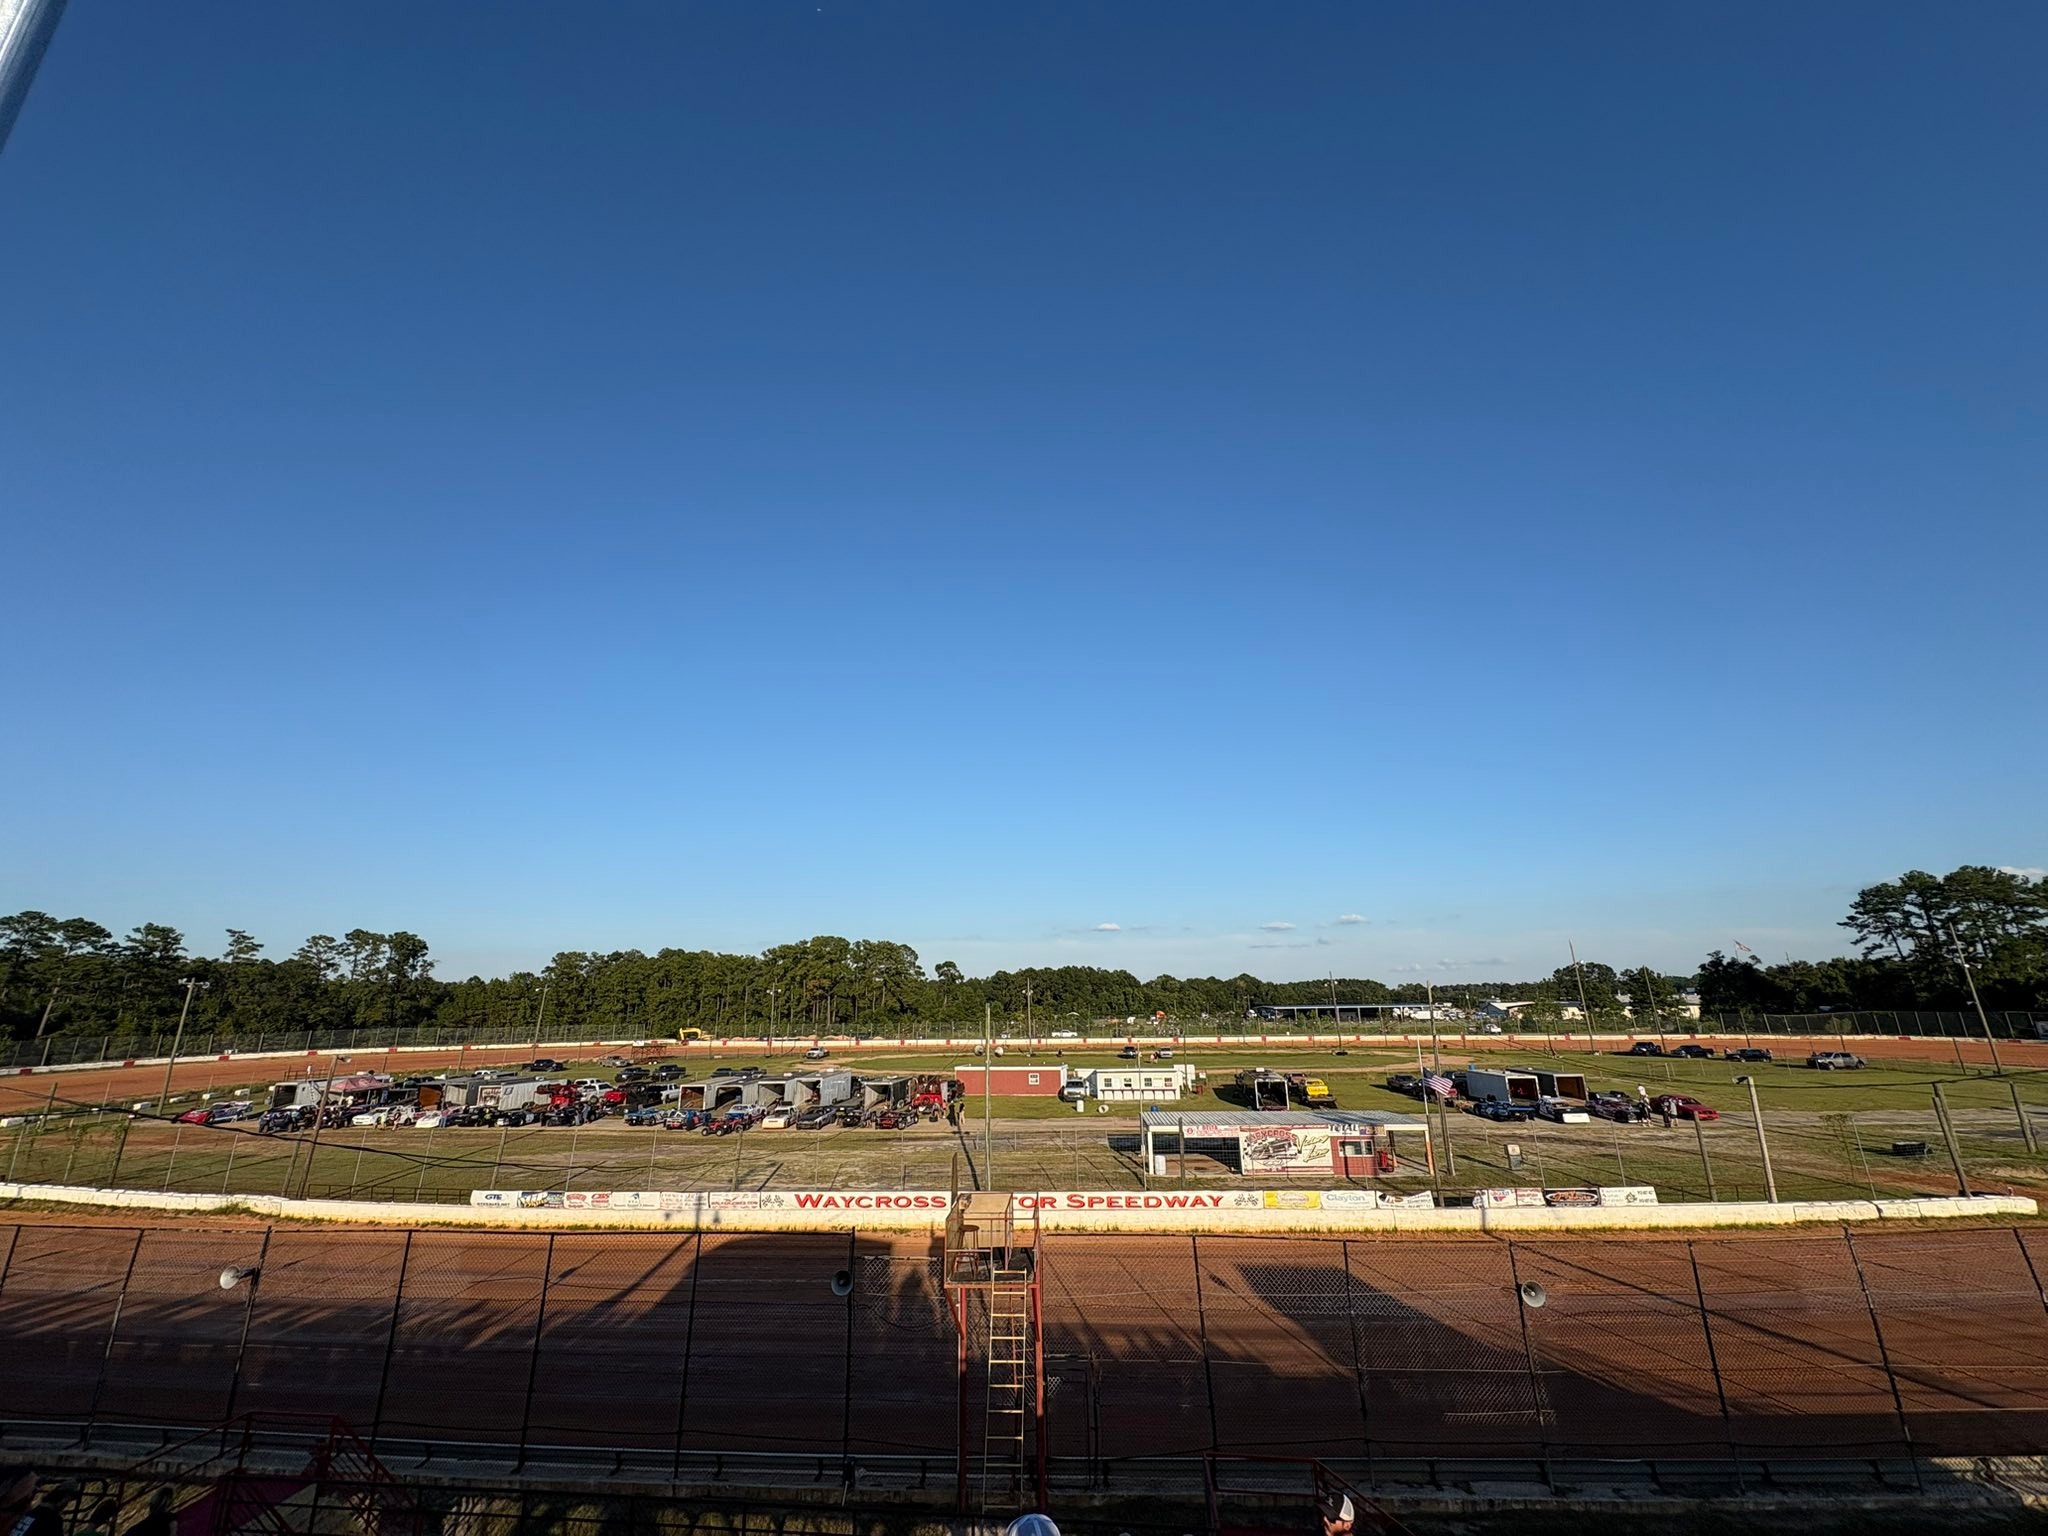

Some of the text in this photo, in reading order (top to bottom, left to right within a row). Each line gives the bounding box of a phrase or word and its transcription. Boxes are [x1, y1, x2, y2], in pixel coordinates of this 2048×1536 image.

[794, 1194, 948, 1208] WAYCROSS
[1066, 1194, 1224, 1208] SPEEDWAY
[1326, 1194, 1365, 1202] Clayton
